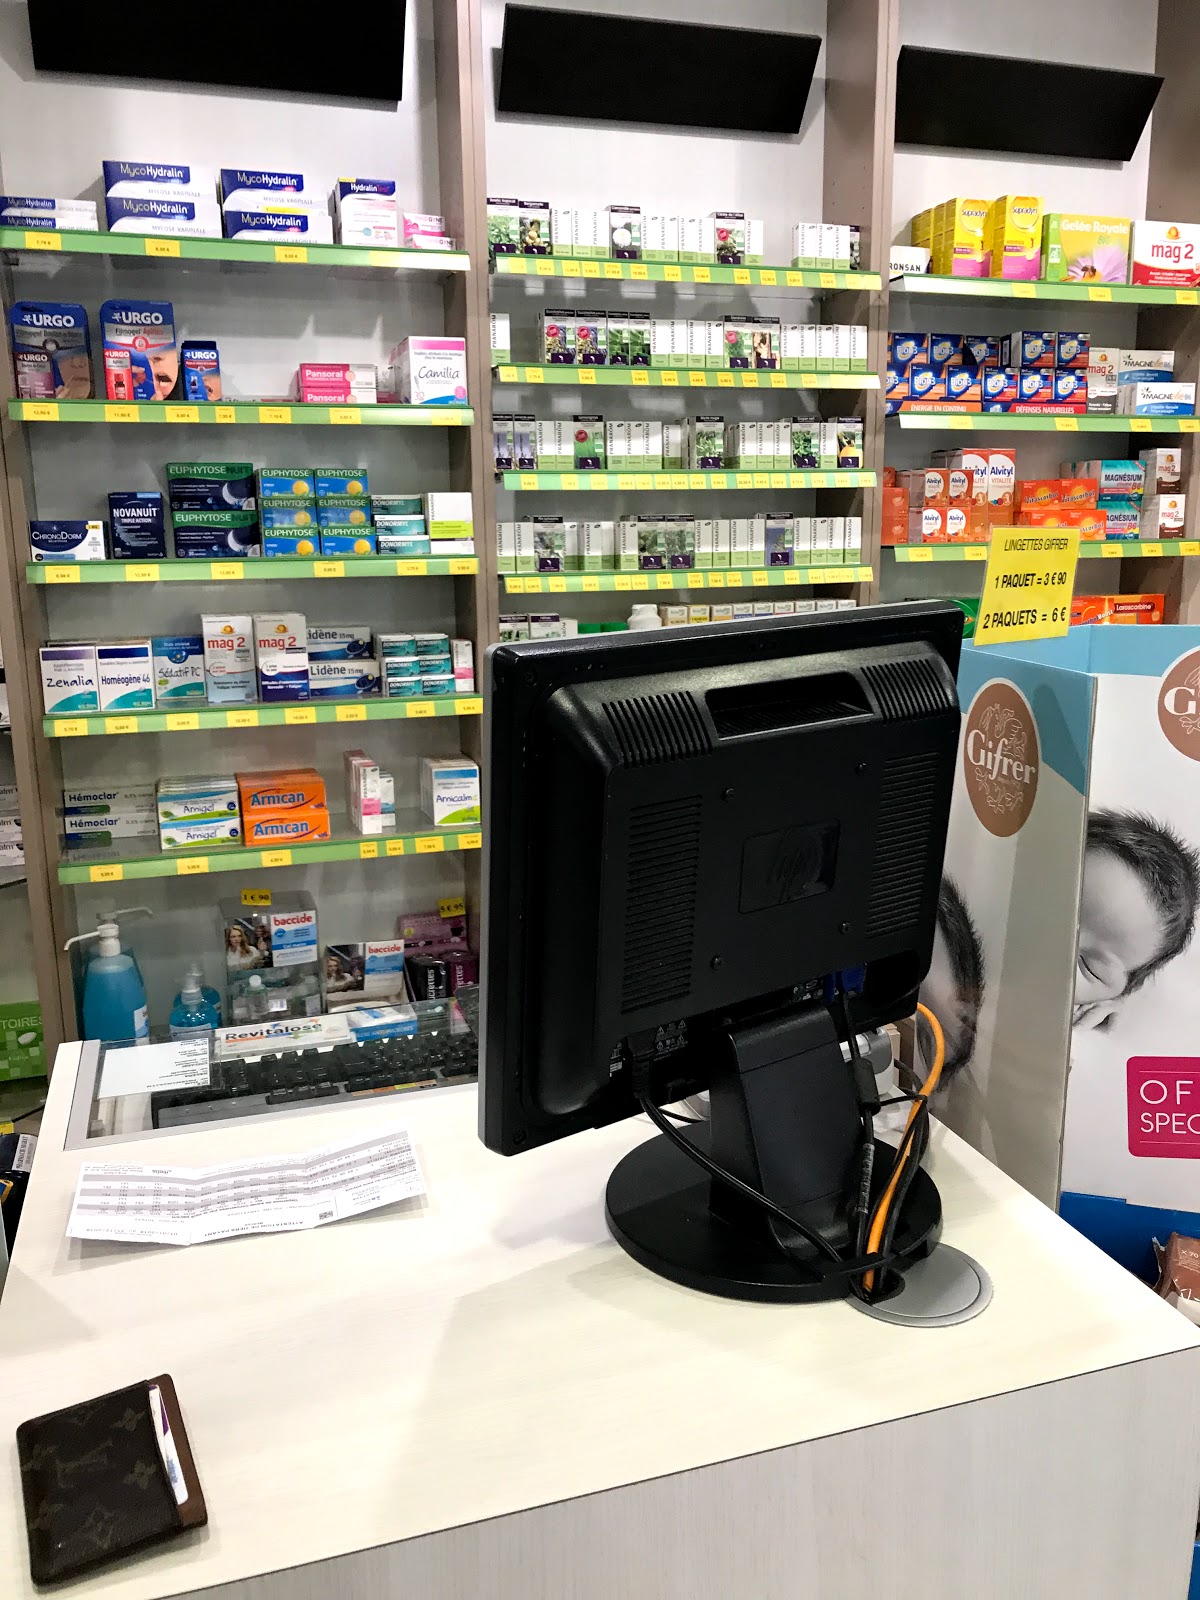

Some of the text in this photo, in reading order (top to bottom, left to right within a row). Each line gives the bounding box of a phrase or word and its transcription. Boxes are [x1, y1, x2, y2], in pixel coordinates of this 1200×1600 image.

[120, 163, 184, 178] MycoHydralin
[237, 172, 298, 186] MycoHydralin
[123, 200, 189, 214] MycoHydralin
[241, 213, 303, 226] MycoHydralin
[1061, 219, 1129, 235] Gelée Royale
[1151, 243, 1195, 264] mag 2
[33, 314, 75, 327] URGO
[121, 312, 163, 324] URGO
[24, 353, 48, 361] URGO
[109, 350, 129, 358] URGO
[191, 351, 217, 359] URGO
[305, 370, 343, 379] Pansoral
[418, 366, 460, 379] Camilia
[1088, 364, 1114, 376] mag 2
[307, 393, 345, 402] Pansoral
[169, 465, 226, 474] EUPHYTOSE
[262, 469, 310, 477] EUPHYTOSE
[990, 465, 1014, 476] Alvityl
[1158, 464, 1176, 473] mag 2
[926, 477, 942, 485] Alvityl
[951, 476, 966, 485] Alvityl
[1104, 473, 1142, 482] MAGNÉSIUM
[319, 499, 366, 507] EUPHYTOSE
[113, 508, 157, 518] NOVANUIT
[175, 513, 232, 522] EUPHYTOSE
[924, 514, 939, 522] Alvityl
[949, 514, 964, 522] Alvityl
[1161, 510, 1180, 520] mag 2
[265, 528, 314, 537] EUPHYTOSE
[323, 528, 371, 536] EUPHYTOSE
[1004, 538, 1069, 551] LINGETTES GIFRER
[995, 577, 1000, 588] 1
[1001, 573, 1036, 588] PAQUET
[1043, 573, 1050, 585] 3
[1051, 573, 1057, 585] €
[1057, 572, 1067, 585] 90
[983, 614, 990, 629] 2
[991, 609, 1037, 628] PAQUETS
[1051, 608, 1058, 622] 6
[1060, 607, 1067, 622] €
[207, 637, 234, 651] mag
[237, 636, 246, 648] 2
[258, 636, 297, 651] mag 2
[158, 666, 202, 678] Sédatif PC
[310, 665, 346, 675] Lidène
[46, 676, 94, 688] Zenalia
[101, 673, 150, 687] Homéogène 46
[967, 729, 1036, 785] Gifrer
[68, 792, 117, 802] Hémoclar
[251, 791, 305, 807] Arnican
[436, 794, 472, 803] Arnicalm
[183, 803, 215, 814] Arnigel
[70, 818, 118, 828] Hémoclar
[254, 821, 309, 836] Arnican
[186, 830, 217, 841] Arnigel
[453, 902, 464, 910] 95
[273, 913, 313, 927] baccide
[368, 945, 402, 954] baccide
[225, 1021, 322, 1041] Revitalose
